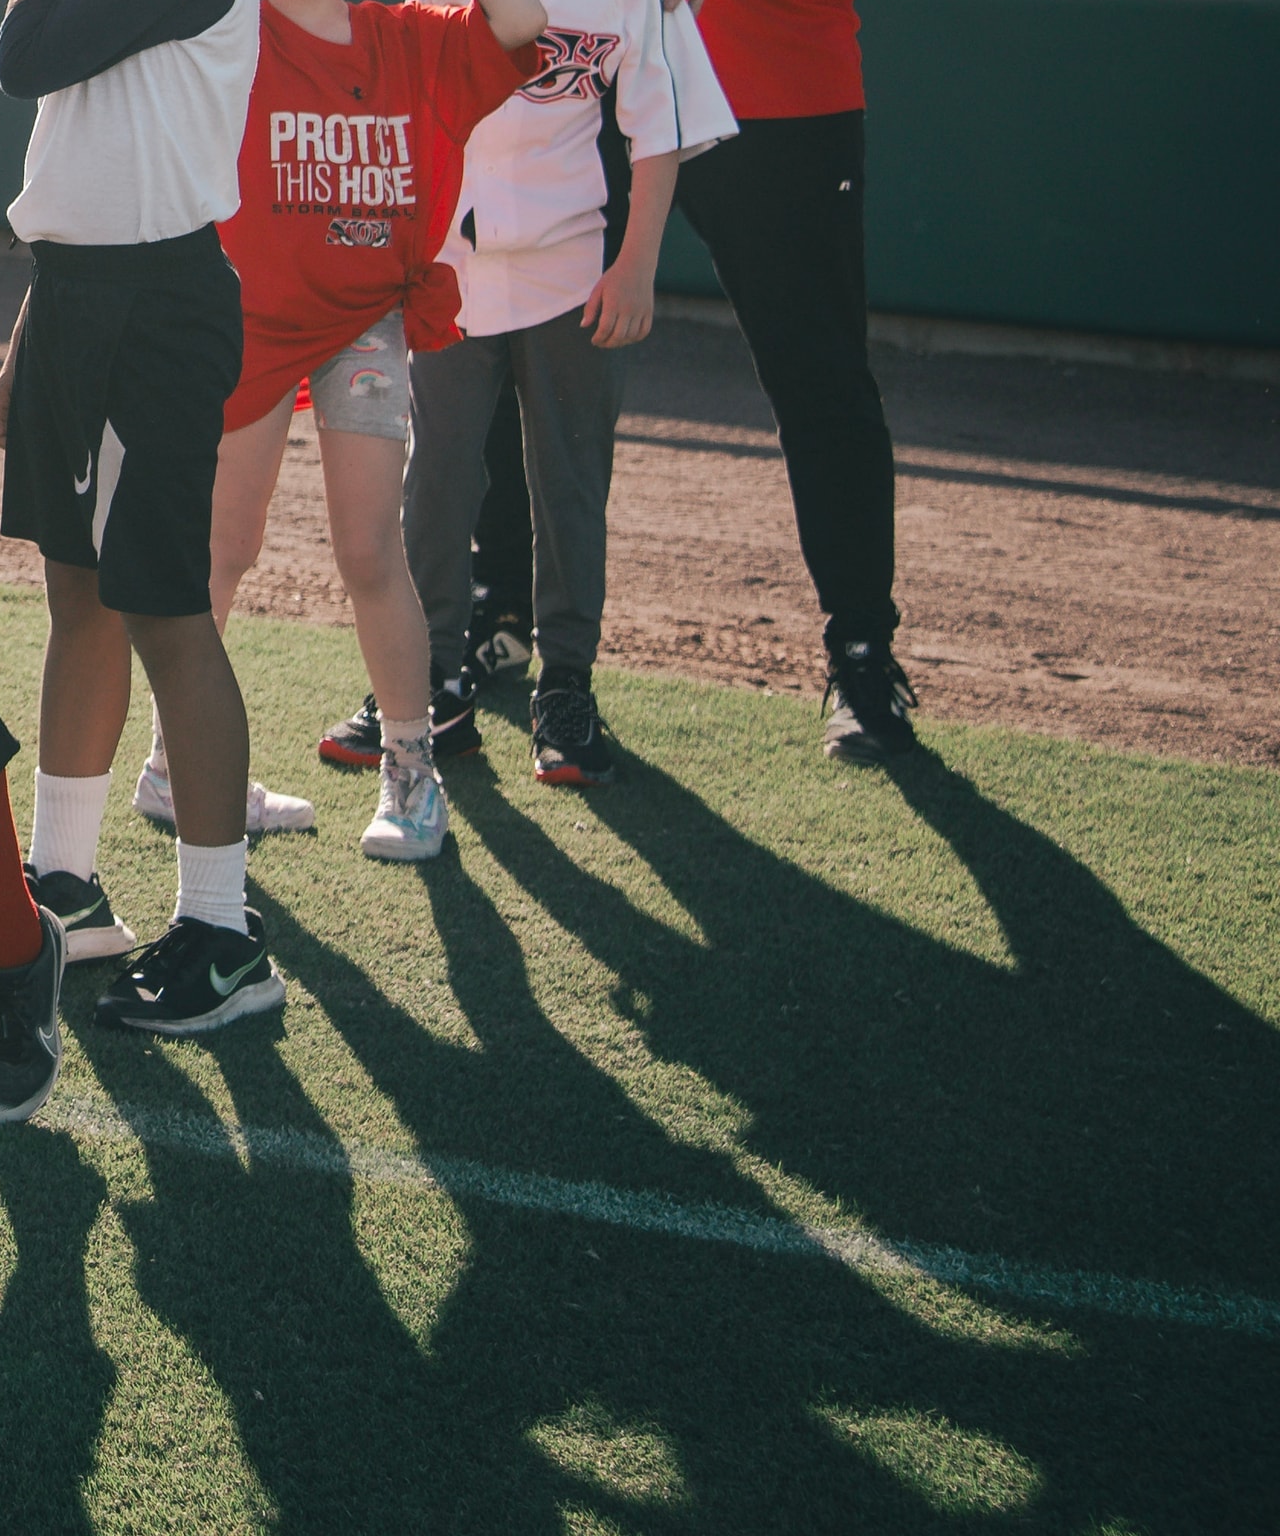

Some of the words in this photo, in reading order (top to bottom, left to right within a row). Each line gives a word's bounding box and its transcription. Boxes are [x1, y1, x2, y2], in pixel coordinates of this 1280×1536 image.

[270, 112, 411, 166] PROTCT
[271, 162, 332, 203] THIS
[271, 203, 342, 215] STORM
